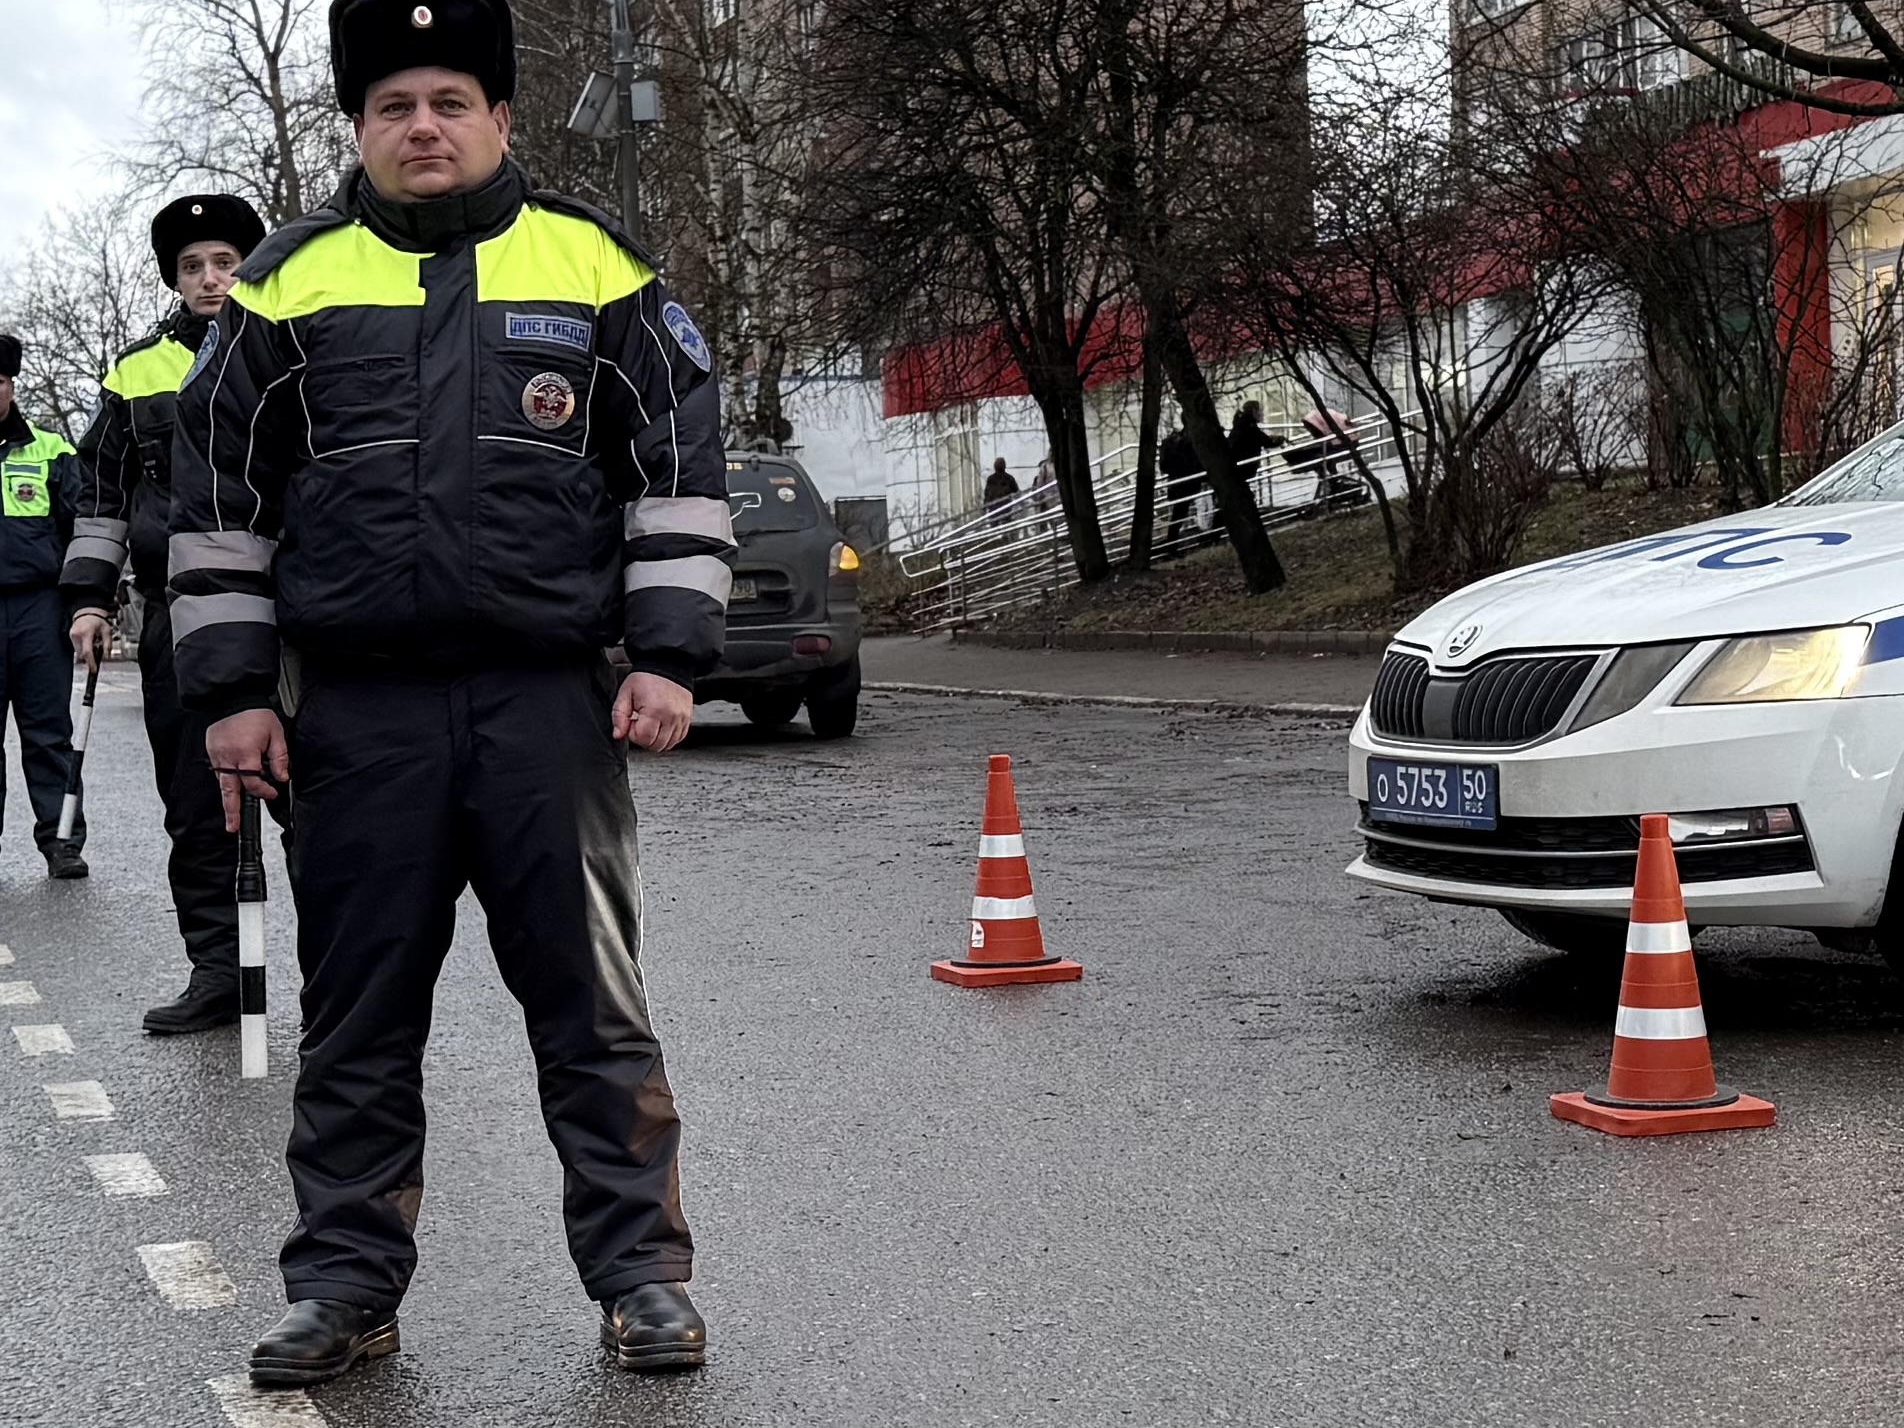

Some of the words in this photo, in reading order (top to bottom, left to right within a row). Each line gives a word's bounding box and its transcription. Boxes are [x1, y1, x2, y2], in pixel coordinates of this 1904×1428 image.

[512, 319, 541, 336] ДПС
[545, 322, 587, 346] ГИБДД
[1396, 766, 1448, 809] 5753
[1462, 768, 1487, 801] 50
